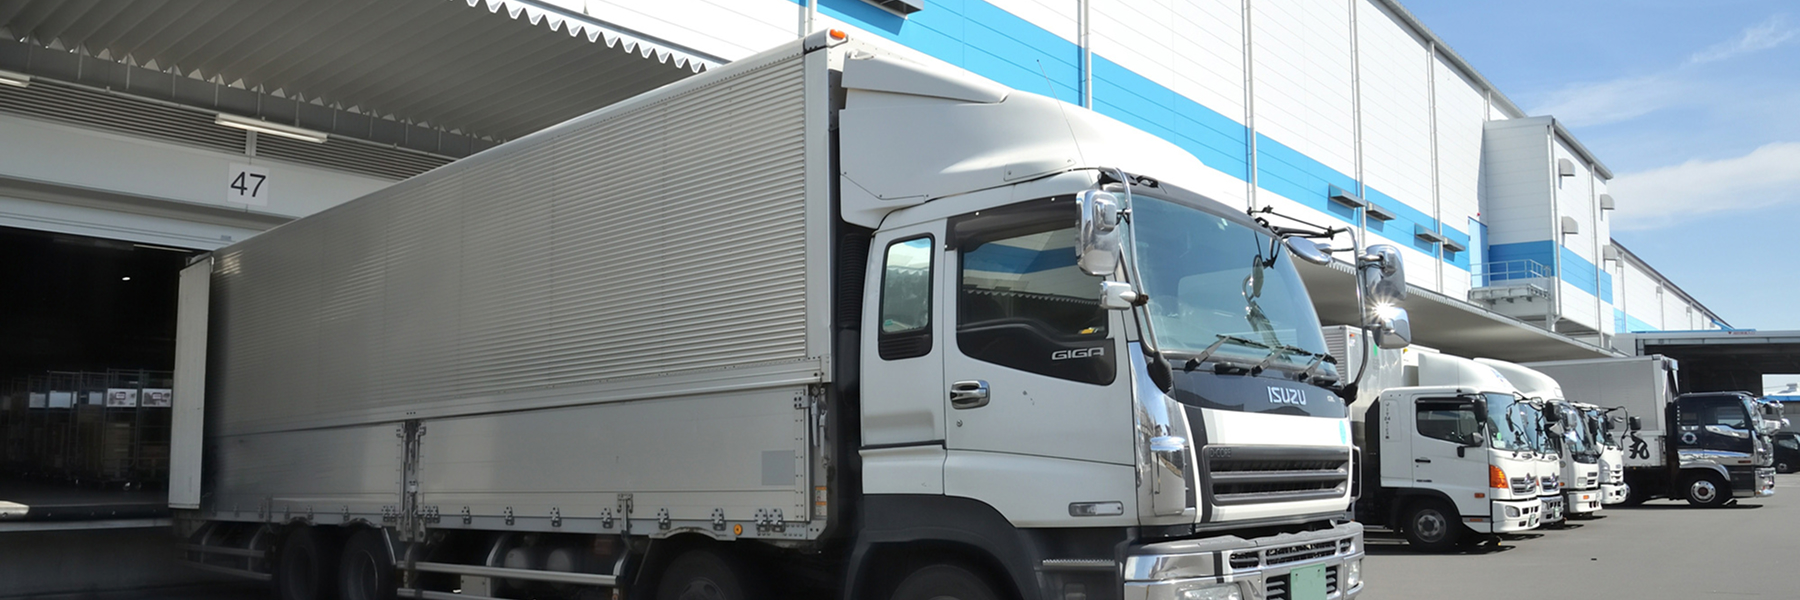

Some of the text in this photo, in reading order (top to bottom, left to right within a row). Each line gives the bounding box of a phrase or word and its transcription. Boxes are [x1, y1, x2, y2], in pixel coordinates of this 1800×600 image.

[230, 171, 266, 197] 47
[1052, 347, 1104, 360] GIGA
[1267, 386, 1306, 405] ISUZU
